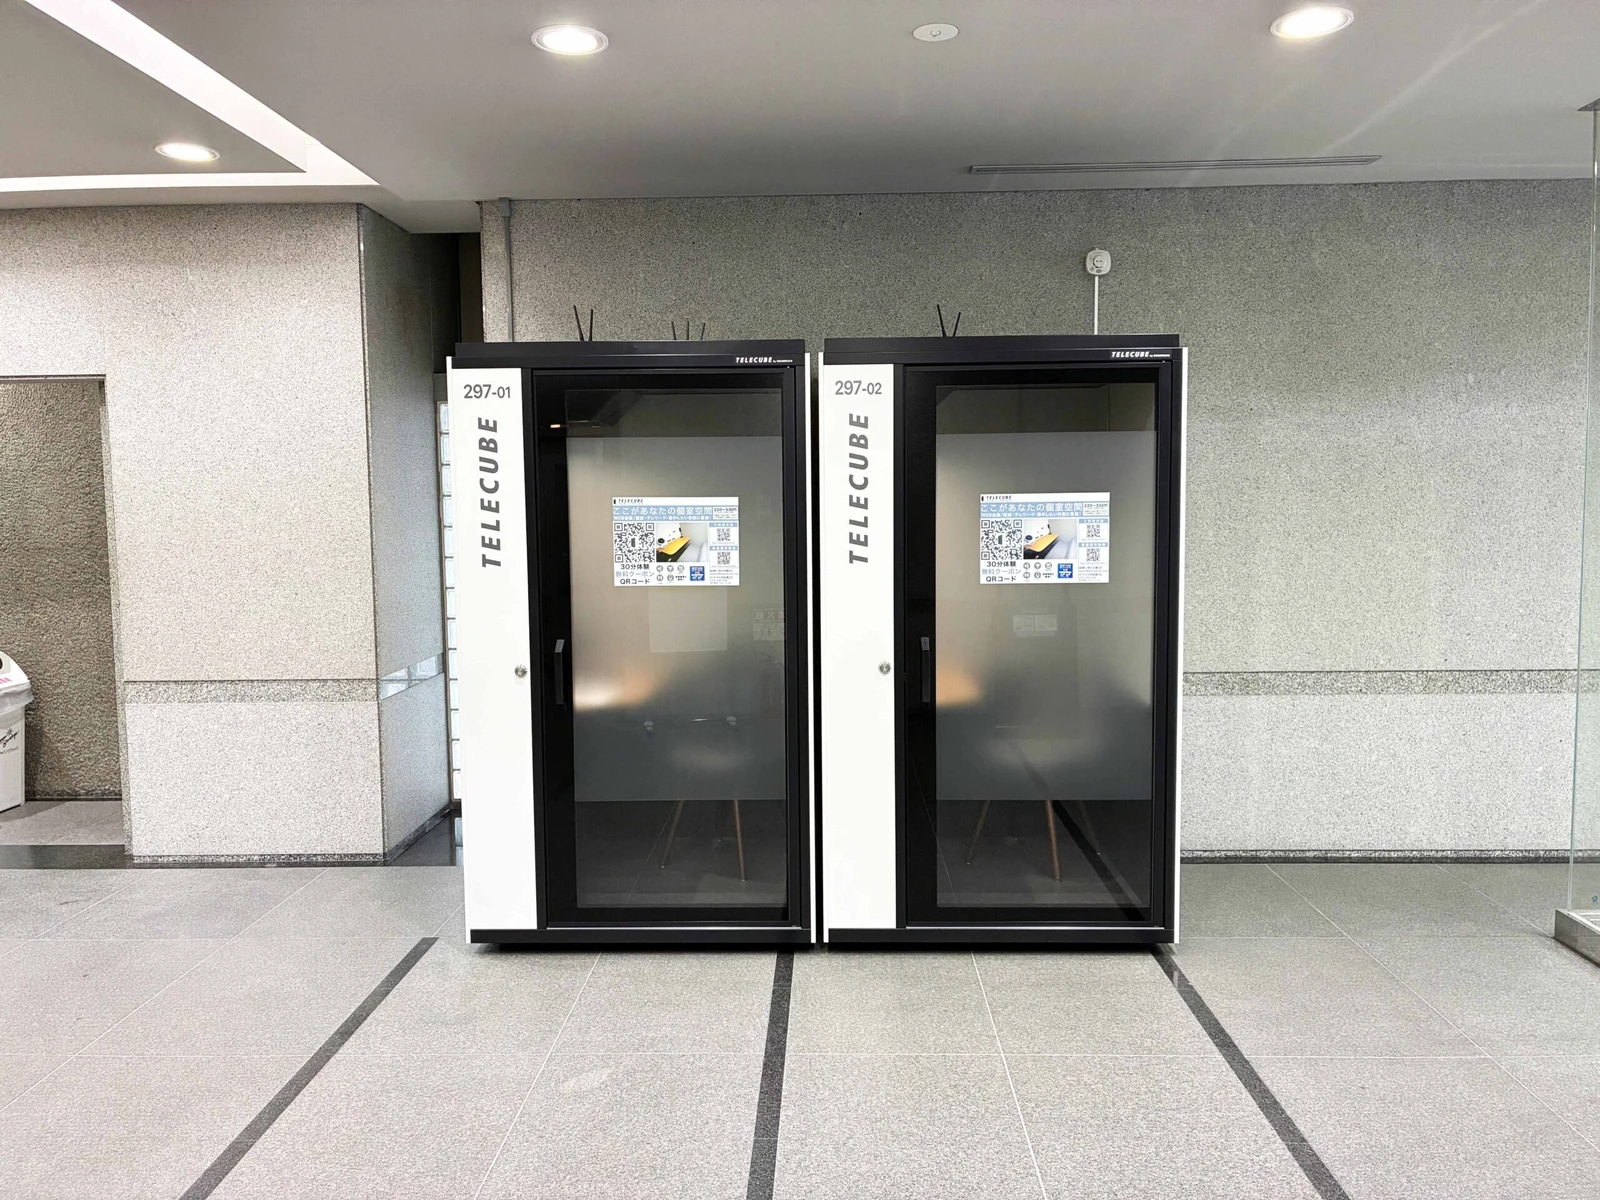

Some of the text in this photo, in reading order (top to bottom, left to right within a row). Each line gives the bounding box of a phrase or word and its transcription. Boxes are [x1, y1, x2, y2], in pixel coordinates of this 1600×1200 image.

[463, 383, 511, 399] 297-01
[835, 380, 882, 396] 297-02
[477, 416, 502, 568] TELECUBE
[848, 413, 869, 564] TELECUBE
[613, 507, 713, 515] ここがあなたの個室空間
[981, 503, 1083, 512] ここがあなたの個室空間
